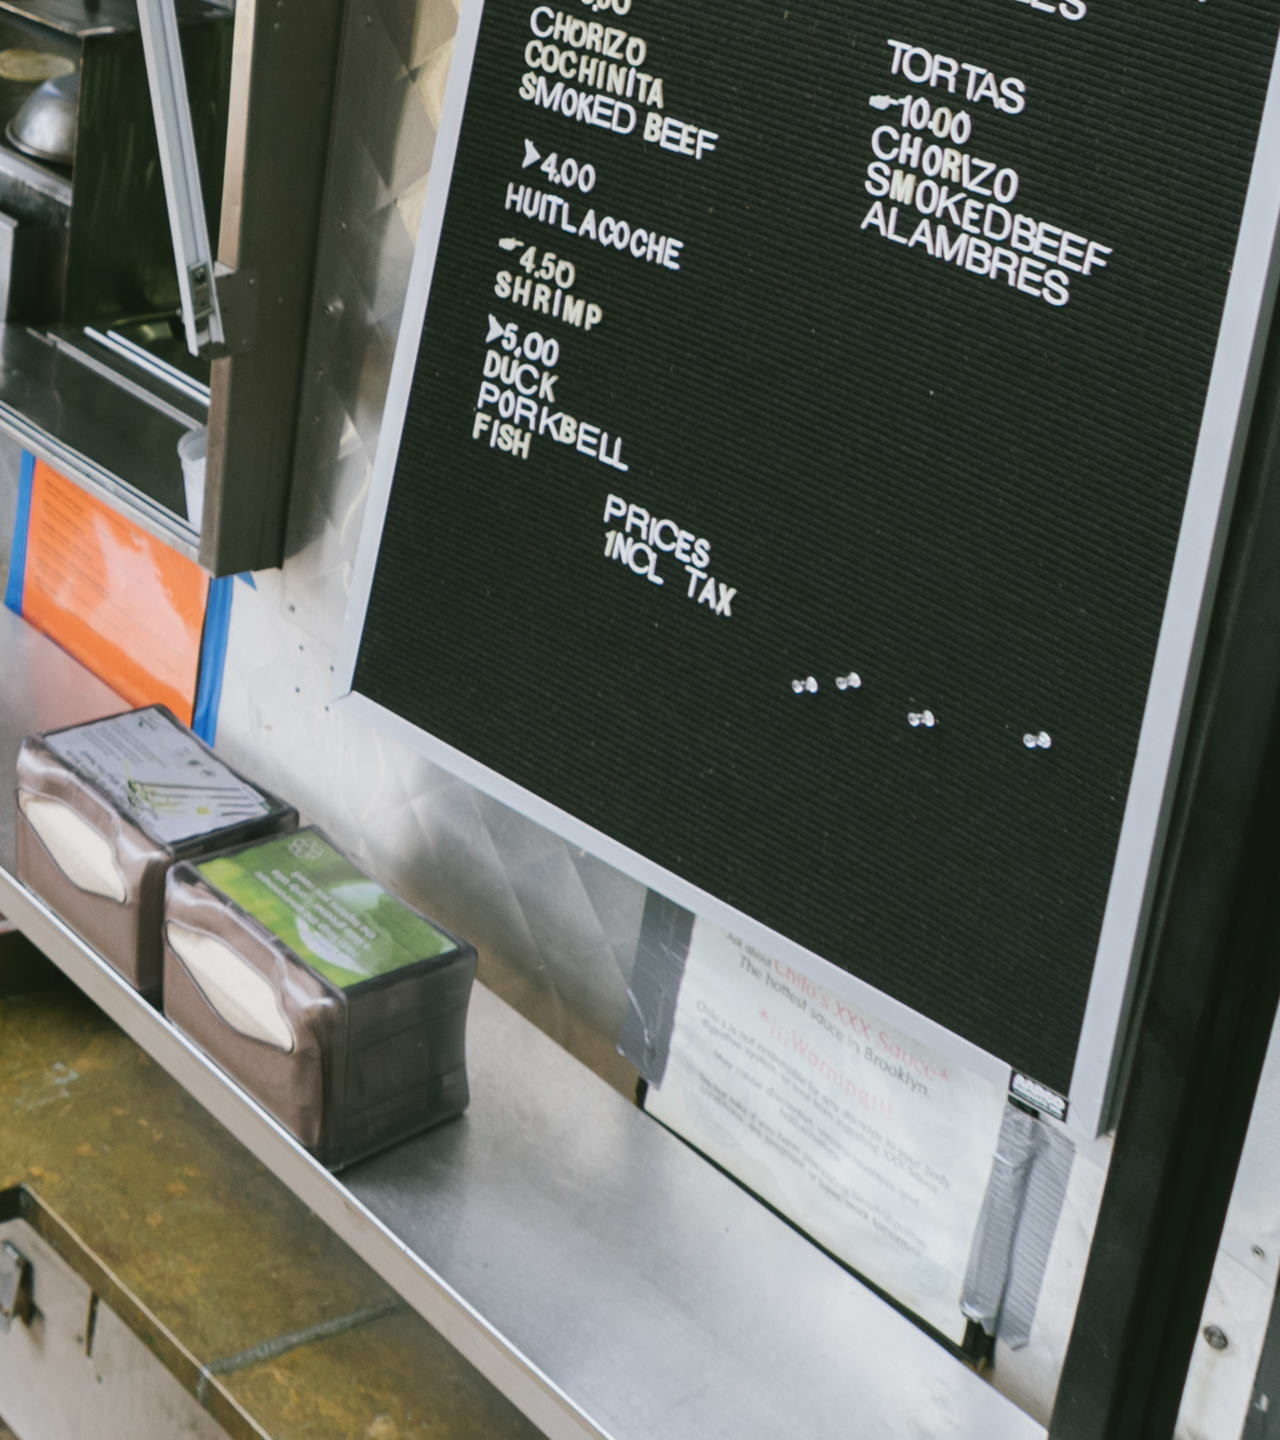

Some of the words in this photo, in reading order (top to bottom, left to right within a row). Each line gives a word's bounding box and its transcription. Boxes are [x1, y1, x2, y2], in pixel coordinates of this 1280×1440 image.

[529, 5, 647, 67] CHORIZO
[524, 39, 664, 109] COCHINITA
[887, 39, 1026, 114] TORTAS
[518, 71, 637, 135] SMOKED
[643, 111, 719, 160] BEEF
[898, 94, 972, 145] 10.00
[540, 152, 596, 193] 4.00
[871, 125, 1019, 204] CHORIZO
[505, 181, 684, 270] HUITLACOCHE
[860, 200, 1070, 306] ALAMBRES
[519, 246, 576, 289] 4.50
[494, 270, 603, 331] SHRIMP
[482, 349, 559, 403] DUCK
[472, 411, 532, 460] FISH
[603, 493, 711, 568] PRICES
[684, 564, 738, 617] TAX
[834, 999, 872, 1042] XXX
